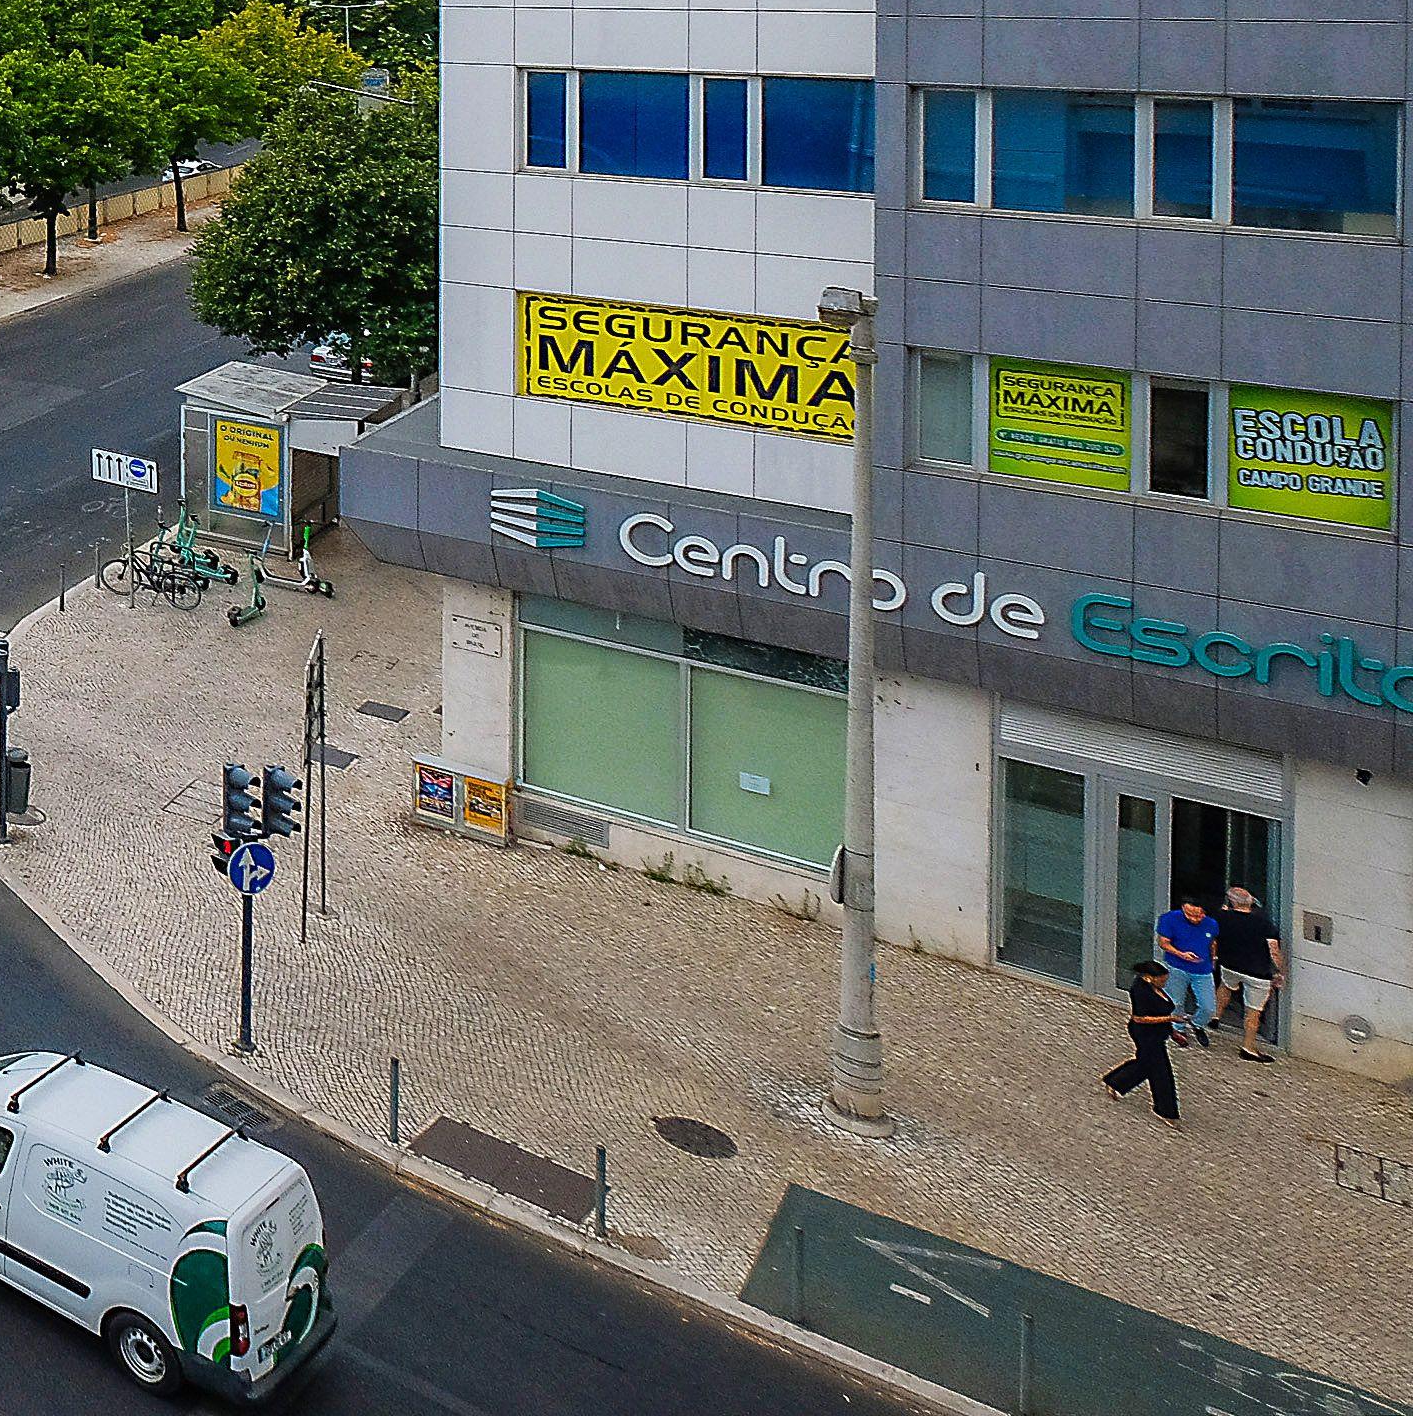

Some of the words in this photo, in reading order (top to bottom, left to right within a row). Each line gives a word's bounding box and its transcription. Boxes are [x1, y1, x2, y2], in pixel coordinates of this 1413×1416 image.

[537, 304, 853, 368] SEGURANÇA
[537, 334, 856, 408] MÁXIMA
[1003, 375, 1116, 399] SEGURANÇA
[537, 374, 653, 402] ESCOLAS
[666, 392, 701, 410] DE
[713, 399, 855, 431] CONDUÇÃ
[1003, 390, 1115, 416] MÁXIMA
[229, 426, 274, 442] ORIGINAL
[1233, 408, 1385, 450] ESCOLA
[1235, 436, 1386, 471] CONDUÇÃO
[1237, 468, 1303, 491] CAMPO
[1307, 474, 1385, 499] GRANDE
[619, 512, 907, 611] Centro
[930, 572, 1045, 640] de
[42, 1157, 74, 1169] WHITE
